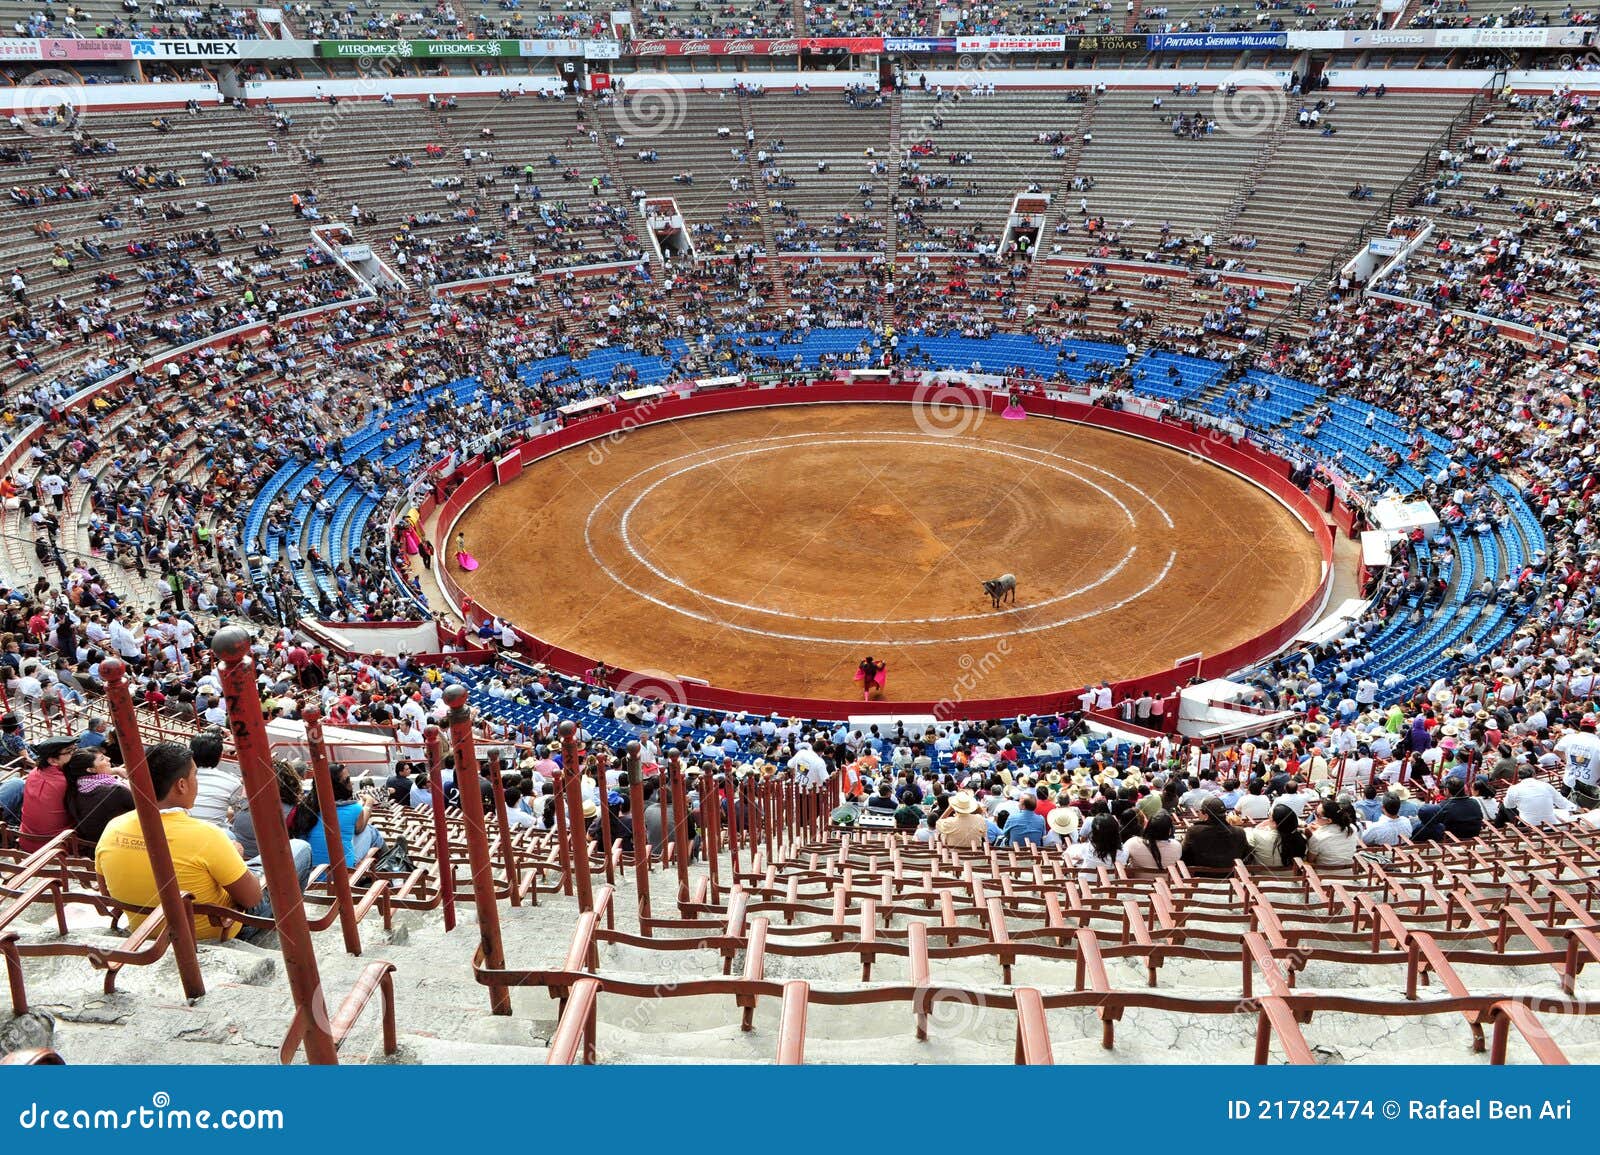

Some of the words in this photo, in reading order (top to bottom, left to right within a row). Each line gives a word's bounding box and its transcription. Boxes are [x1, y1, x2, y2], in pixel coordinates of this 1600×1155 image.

[886, 43, 930, 51] CALMEX
[1164, 37, 1204, 47] PINTURAS
[160, 42, 239, 55] TELMEX
[338, 44, 397, 54] VITROMEX
[428, 44, 487, 54] VITROMEX
[564, 62, 575, 73] 16
